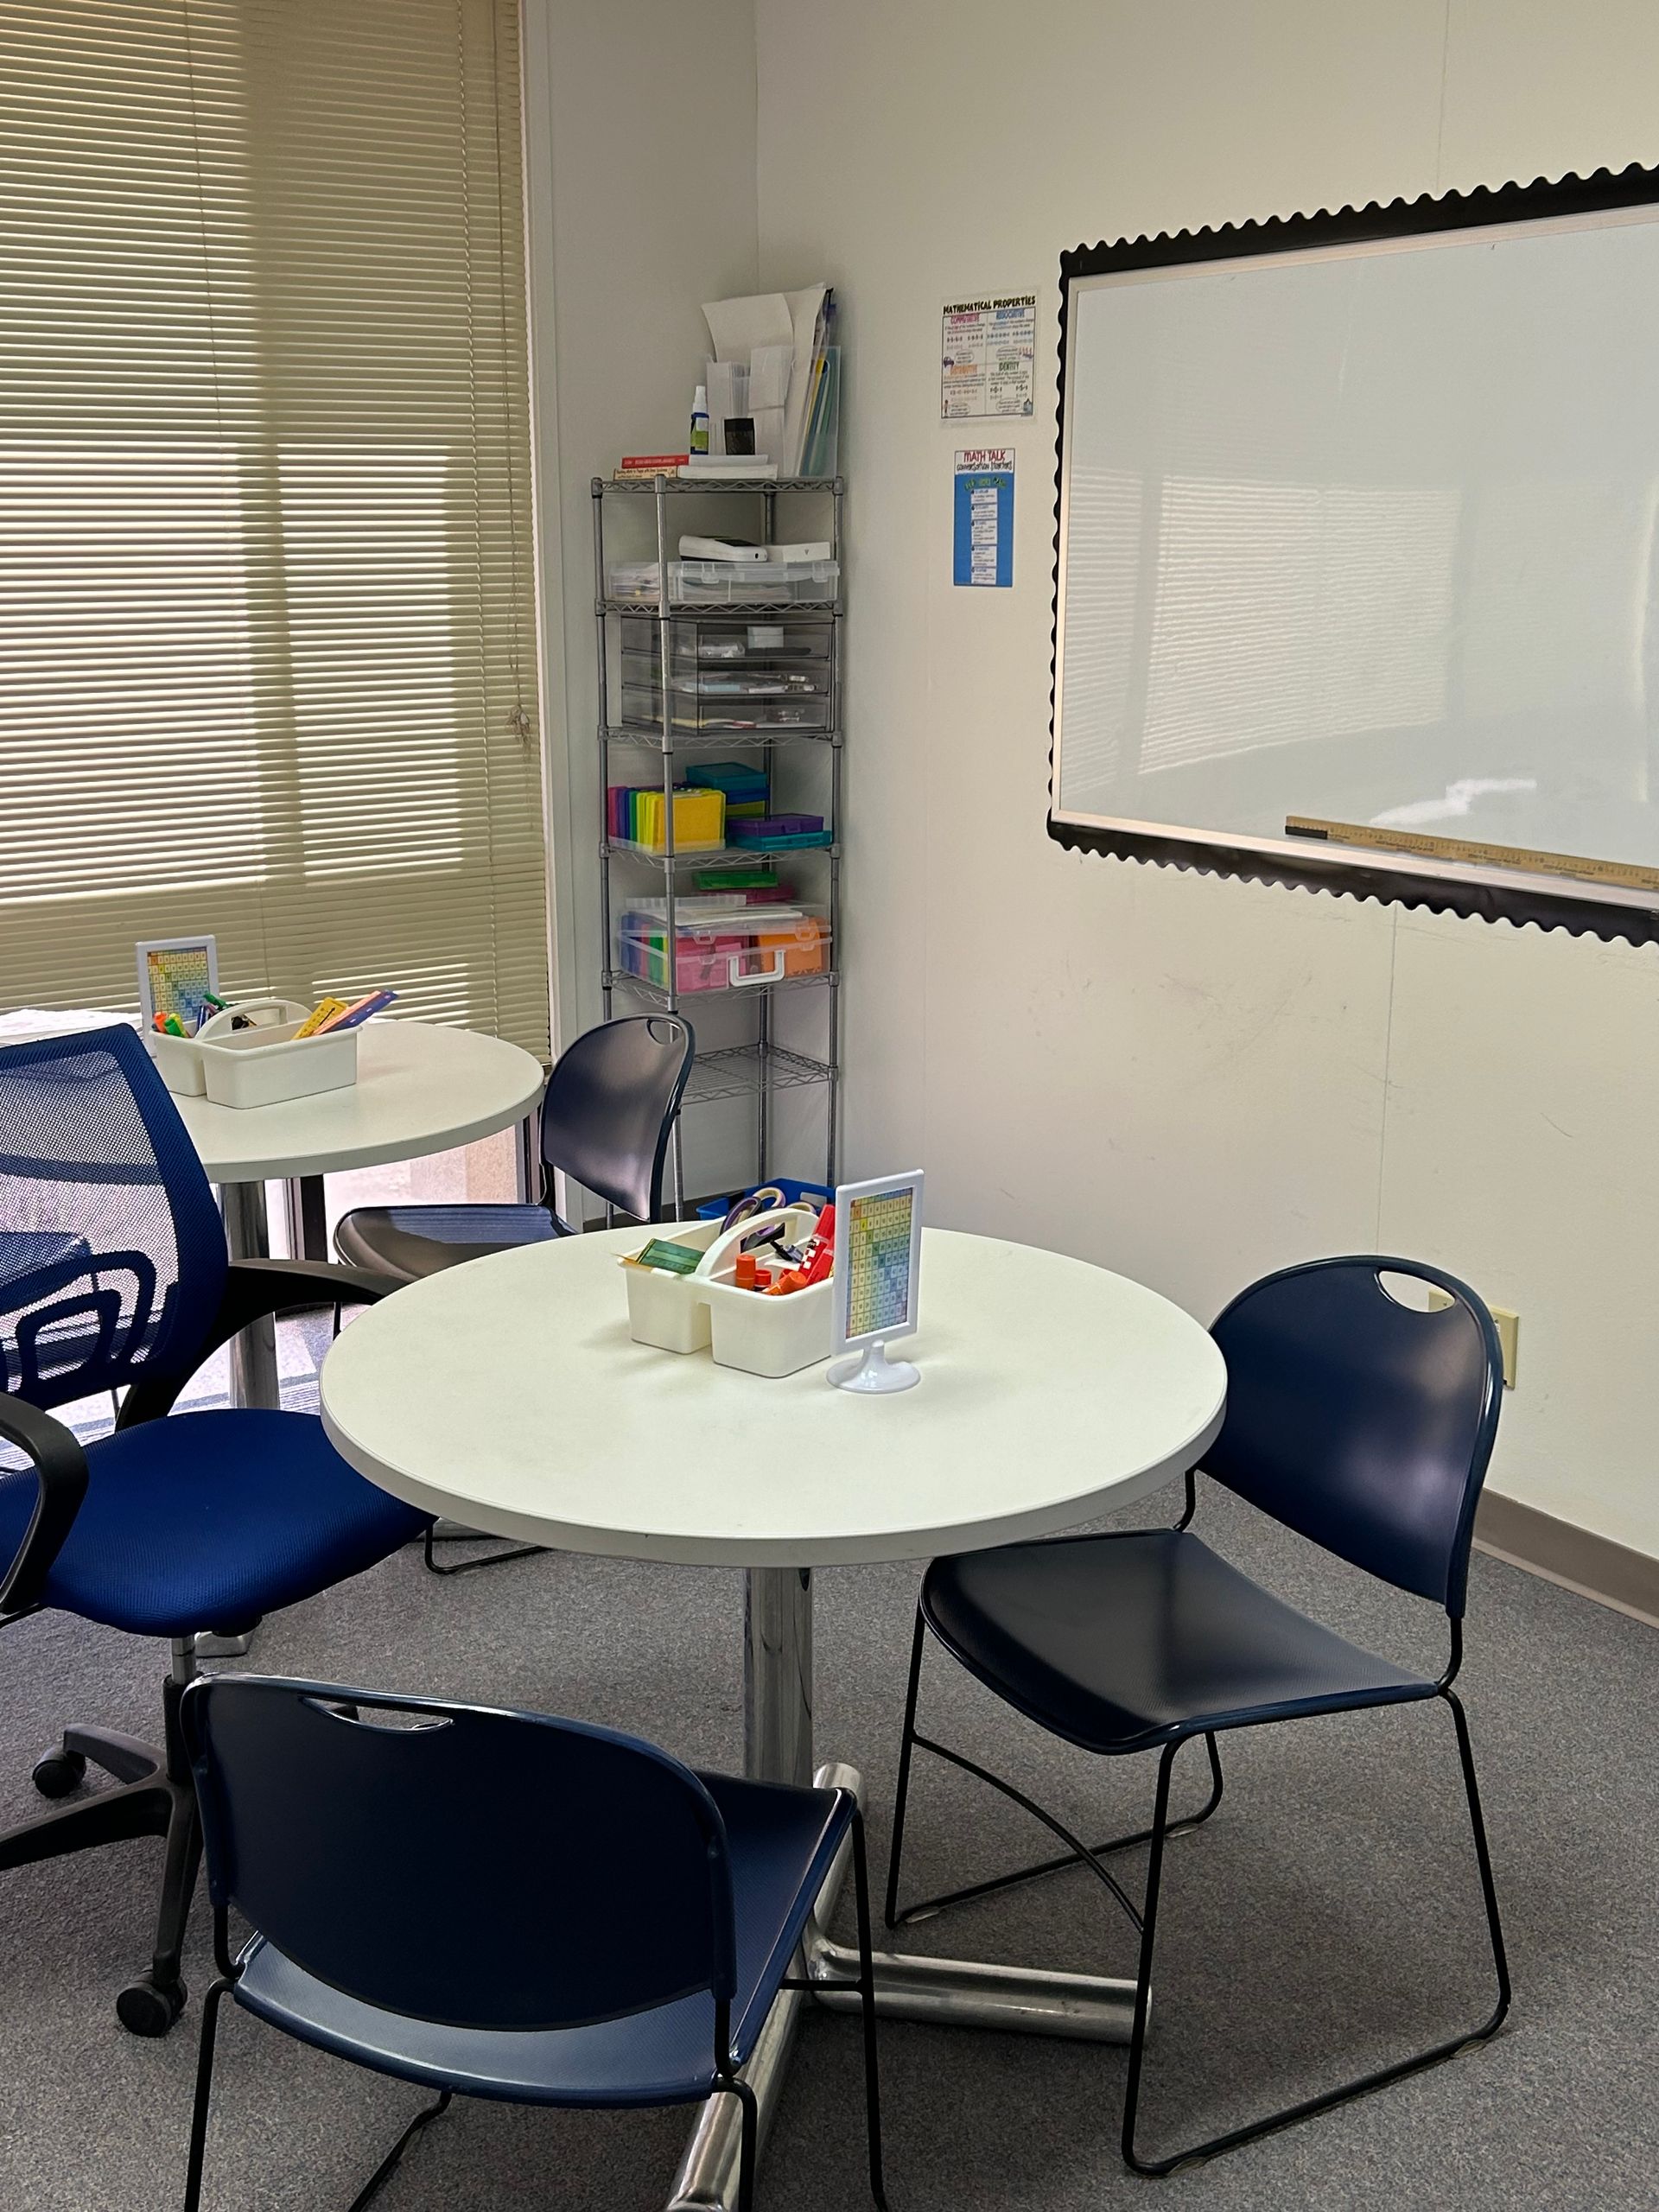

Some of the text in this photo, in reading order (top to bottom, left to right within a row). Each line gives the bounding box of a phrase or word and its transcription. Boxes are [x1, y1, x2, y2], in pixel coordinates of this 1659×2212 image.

[944, 296, 1035, 315] MATHEMATICAL PROPERTIES
[963, 449, 1006, 462] MATH TALK
